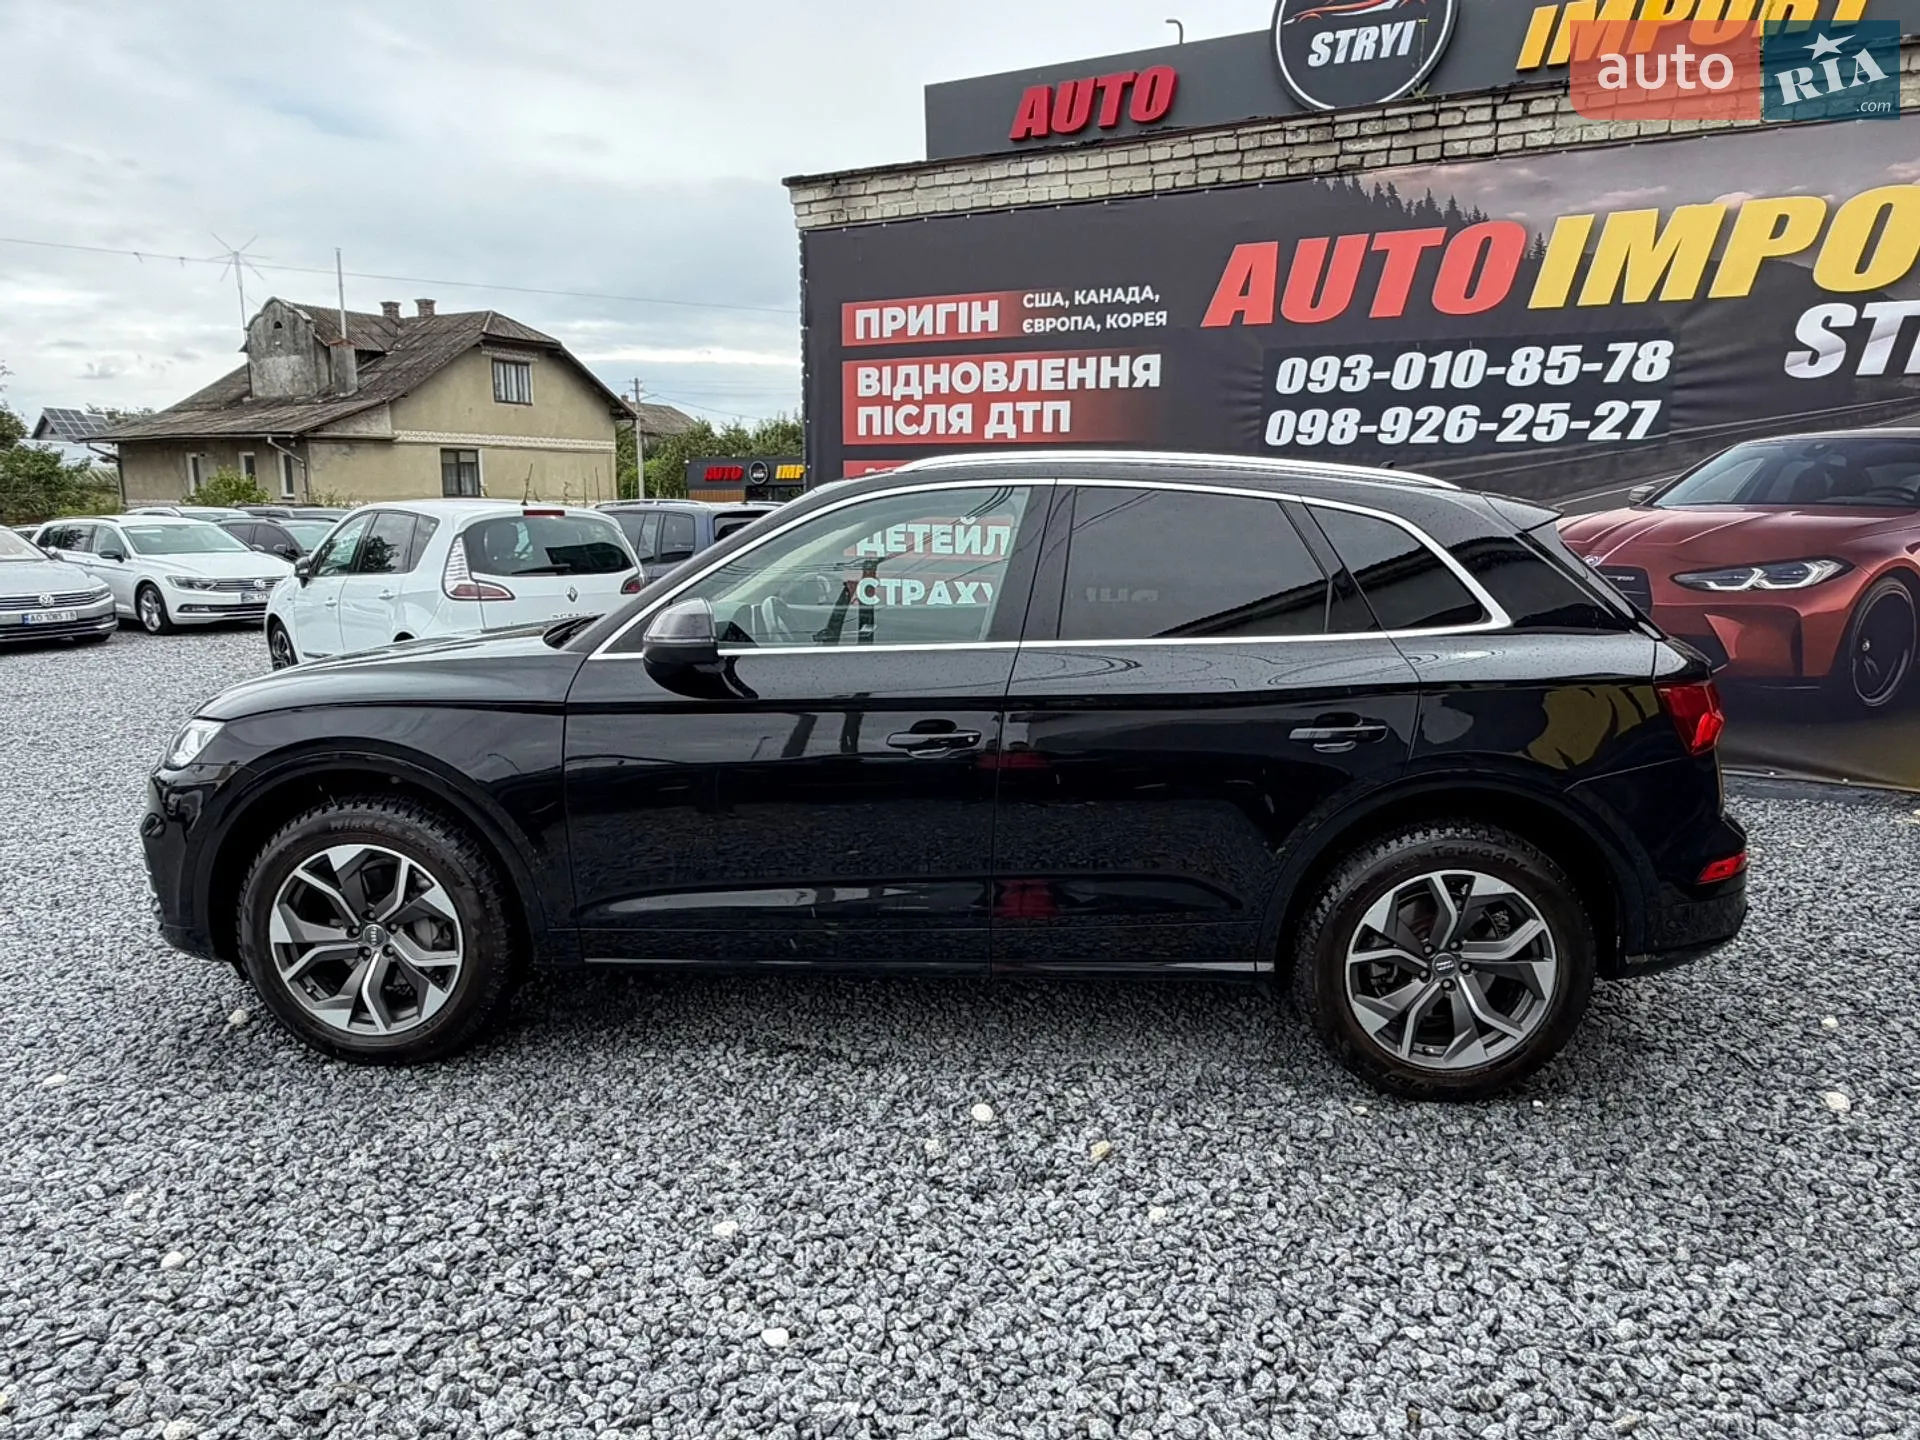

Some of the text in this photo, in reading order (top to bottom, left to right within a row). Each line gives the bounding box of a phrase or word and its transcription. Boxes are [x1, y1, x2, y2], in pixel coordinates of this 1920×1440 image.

[1307, 20, 1416, 67] STRYI
[1009, 65, 1177, 141] AUTO
[855, 299, 999, 340] ПРИГІН
[1022, 285, 1160, 308] США, КАНАДА,
[1022, 310, 1168, 333] ЄВРОПА, КОРЕЯ
[857, 353, 1162, 401] ВІДНОВЛЕННЯ
[1275, 340, 1675, 395] 093-010-85-78
[857, 400, 1071, 439] ПІСЛЯ ДТП
[1264, 399, 1662, 446] 098-926-25-27
